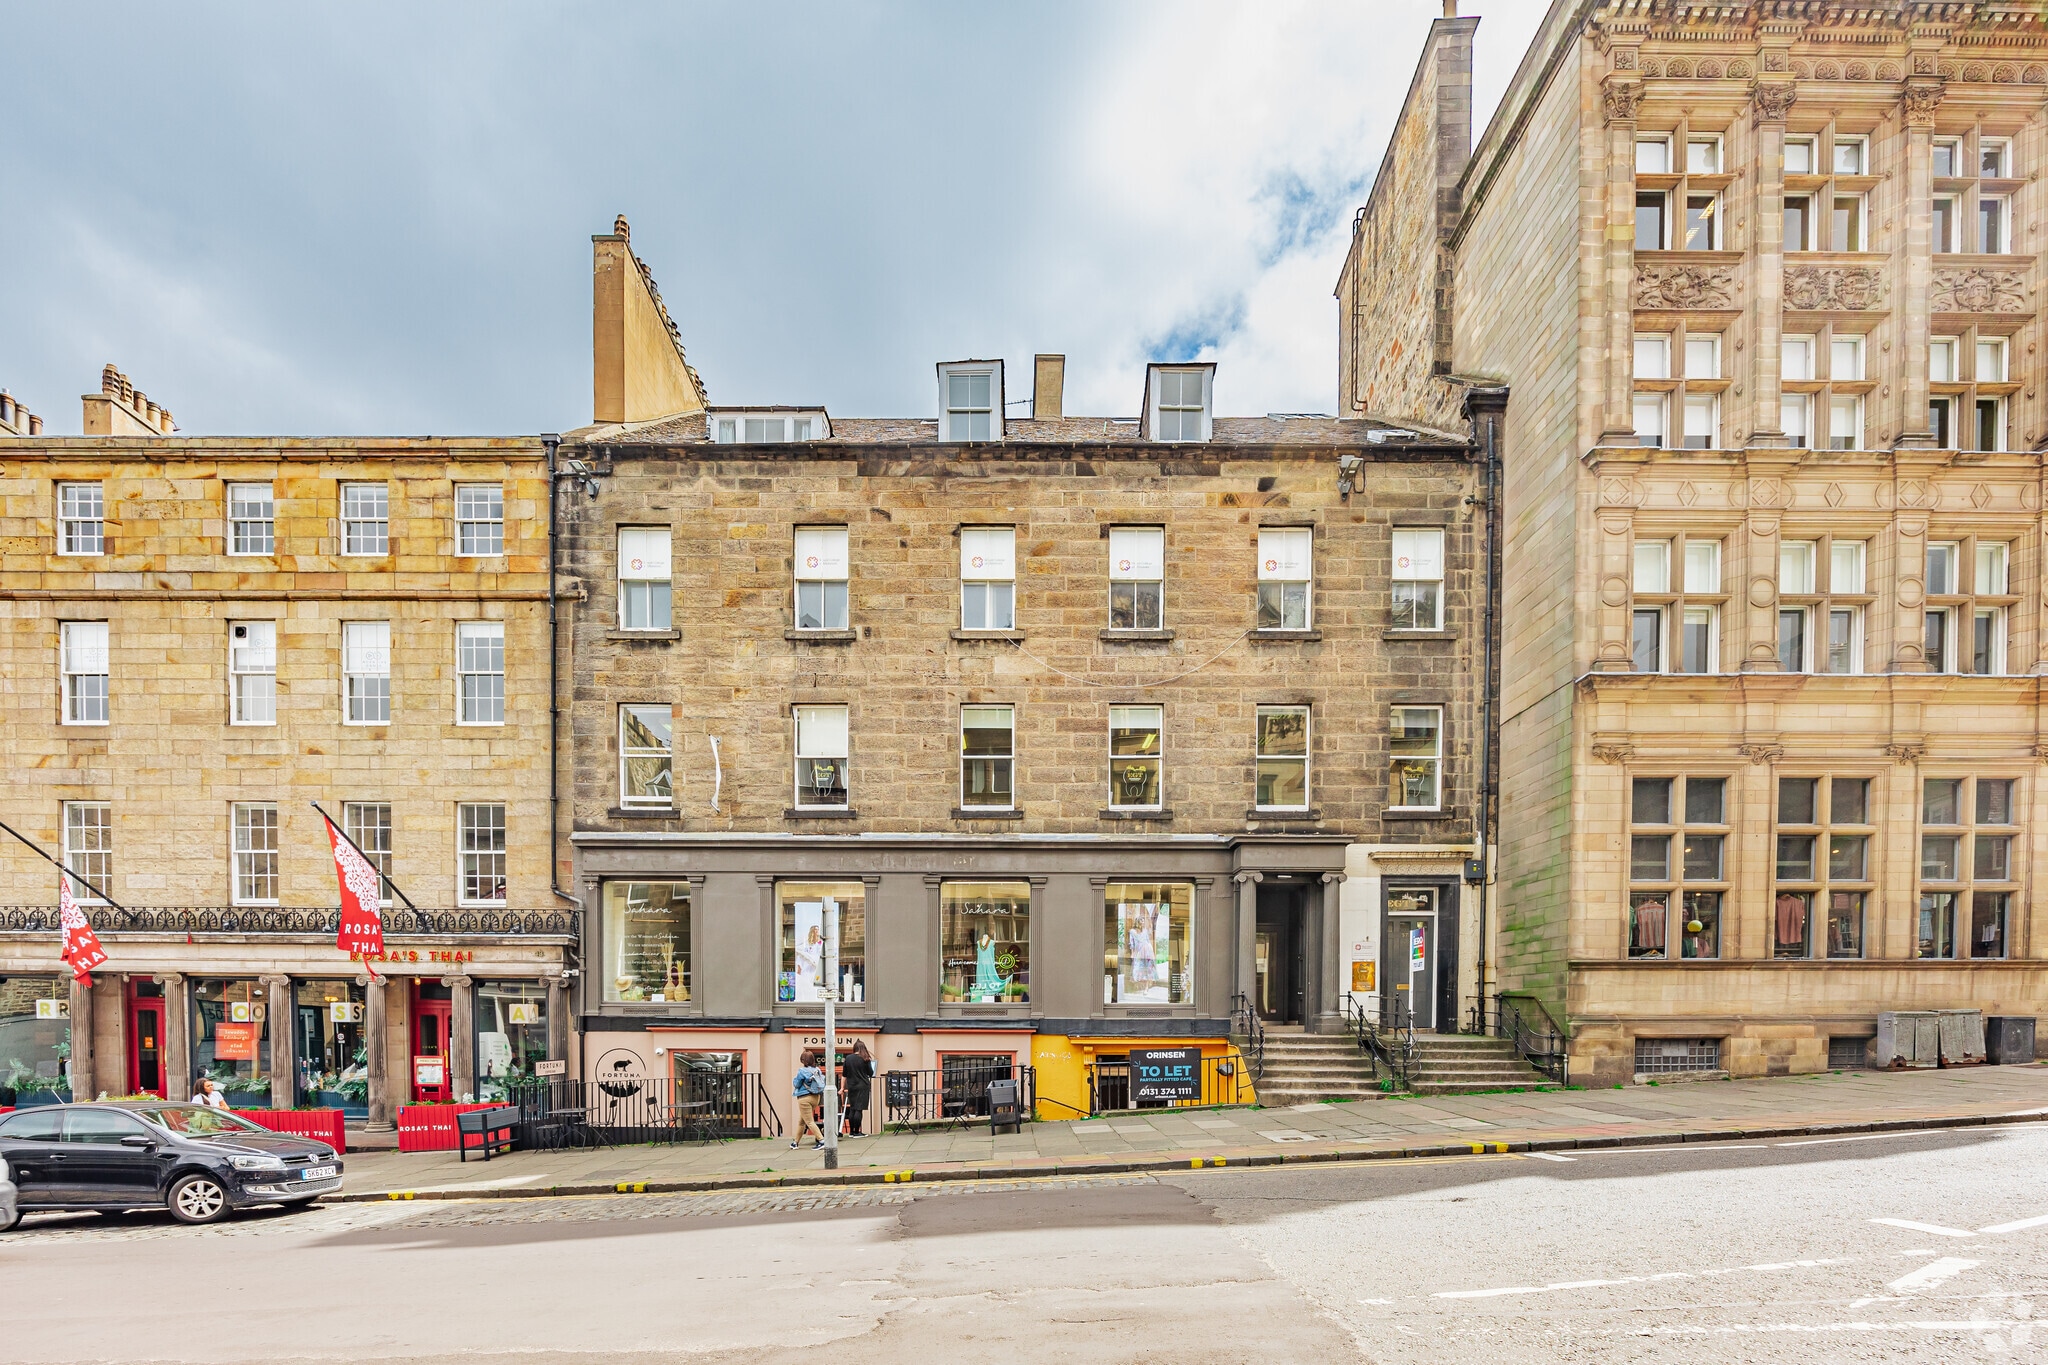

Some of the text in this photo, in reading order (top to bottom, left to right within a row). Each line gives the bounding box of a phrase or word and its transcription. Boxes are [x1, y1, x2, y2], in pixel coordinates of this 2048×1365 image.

[624, 902, 672, 914] Sahara
[960, 902, 1010, 915] Sahara
[350, 950, 473, 962] ROSA'S THAI
[335, 1005, 361, 1020] S S
[1146, 1051, 1186, 1059] ORINSEN
[1139, 1065, 1193, 1077] TO LET
[1139, 1088, 1159, 1096] 0131
[1177, 1087, 1193, 1095] 1111
